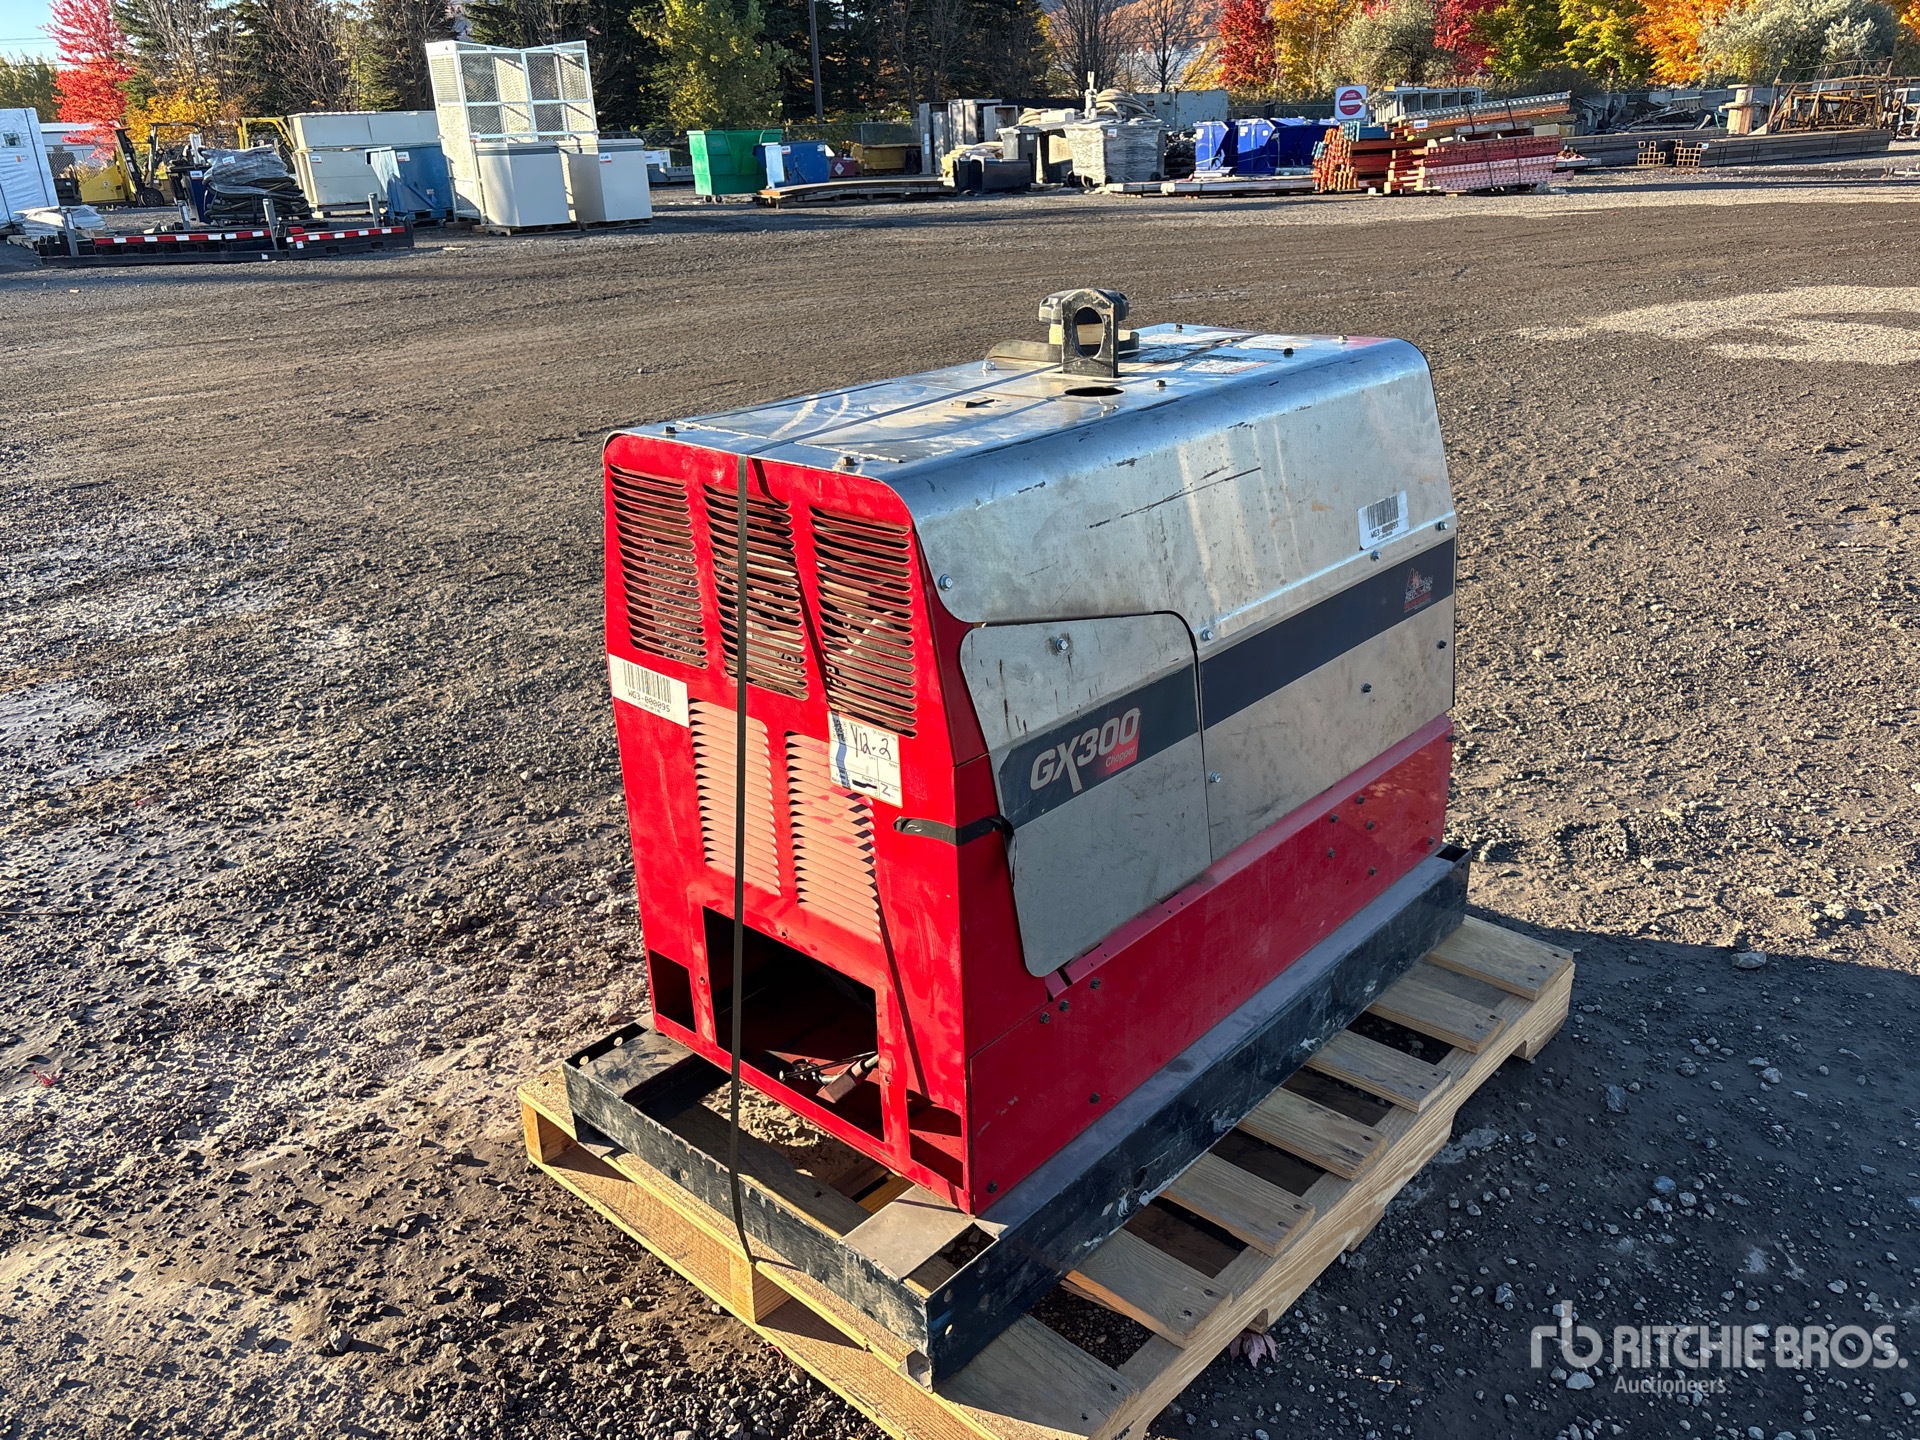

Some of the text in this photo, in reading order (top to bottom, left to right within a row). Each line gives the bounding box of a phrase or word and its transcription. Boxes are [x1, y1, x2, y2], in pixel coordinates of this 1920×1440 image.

[627, 689, 671, 713] WG3-000095
[1030, 707, 1141, 793] GX300
[1104, 745, 1136, 768] Chopper
